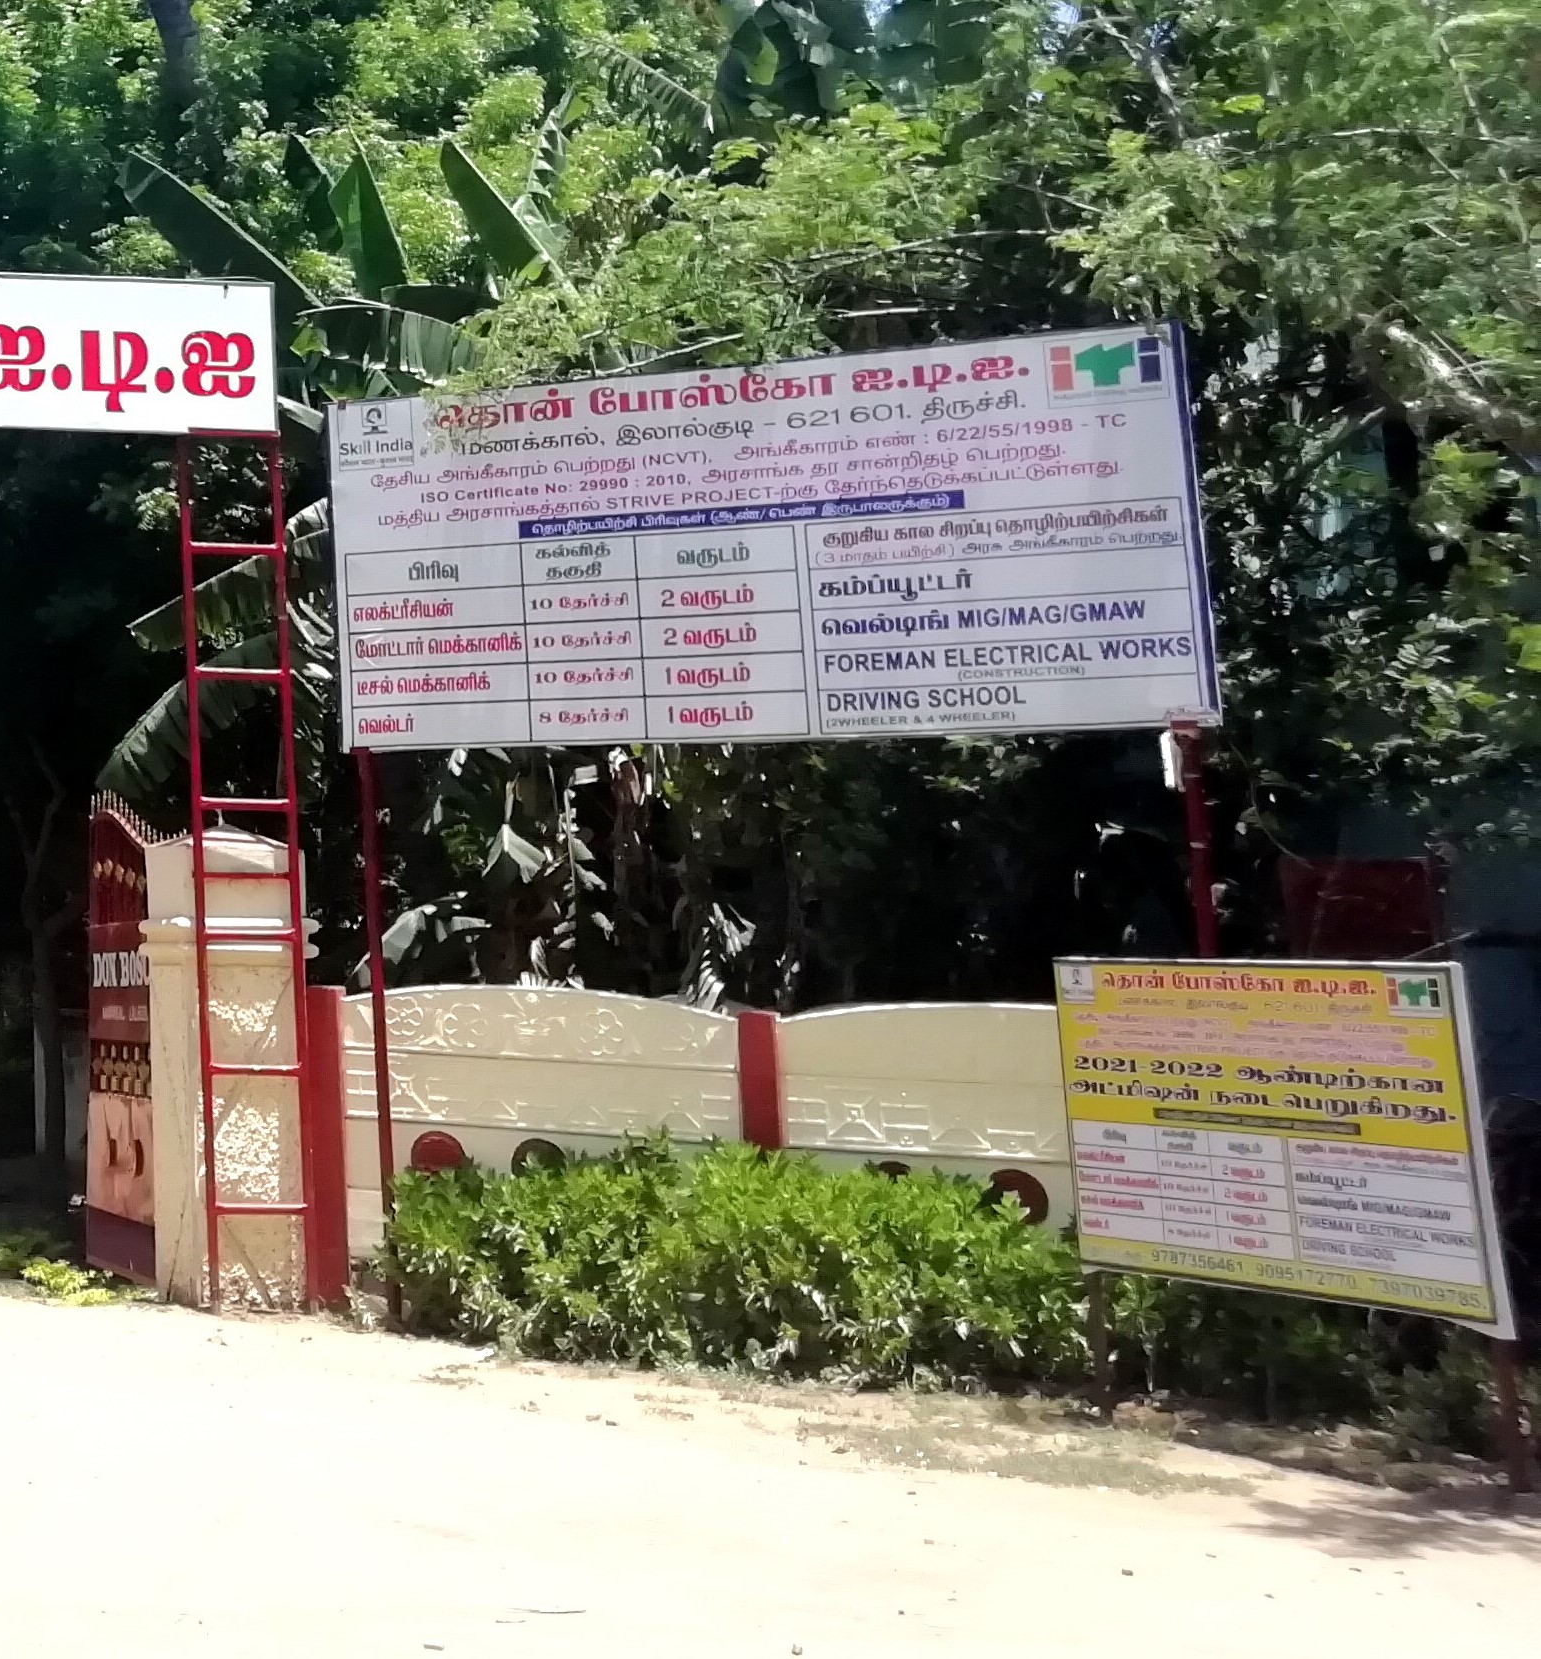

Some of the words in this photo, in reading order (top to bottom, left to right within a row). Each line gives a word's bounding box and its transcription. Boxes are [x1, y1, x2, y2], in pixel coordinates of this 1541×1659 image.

[589, 372, 836, 416] போஸ்கோ
[852, 355, 1031, 393] ஐ.டி.ஐ.
[460, 425, 606, 456] மணக்கால்,
[616, 416, 755, 446] இலால்குடி
[787, 408, 840, 430] 621
[920, 389, 1027, 424] திருச்சி.
[339, 440, 371, 456] Skill
[375, 437, 413, 453] India
[370, 471, 430, 492] தேசிய
[437, 459, 548, 483] அங்கீகாரம்
[554, 454, 636, 476] பெற்றது
[734, 435, 858, 460] அங்கீகாரம்
[865, 430, 917, 450] எண்
[937, 417, 1073, 444] 6/22/55/1998
[1095, 413, 1128, 430] TC
[420, 490, 450, 505] ISO
[455, 484, 539, 502] Certificate
[545, 481, 573, 495] No:
[579, 477, 629, 493] 29990
[646, 473, 692, 488] 2010,
[702, 461, 804, 484] அரசாங்க
[811, 460, 839, 479] தர
[846, 448, 961, 474] சான்றிதழ்
[966, 440, 1066, 463] பெற்றது.
[378, 508, 441, 530] மத்திய
[446, 497, 601, 523] அரசாங்கத்தால்
[606, 491, 676, 511] STRIVE
[531, 515, 639, 537] தொழிற்பயிற்சி
[641, 512, 707, 528] பிரிவுகள்
[822, 526, 889, 549] குறுகிய
[893, 523, 935, 541] கால
[938, 518, 991, 540] சிறப்பு
[995, 504, 1169, 536] தொழிற்பயிற்சிகள்
[676, 541, 751, 568] வருடம்
[408, 560, 459, 582] பிரிவு
[545, 561, 602, 581] தகுதி
[660, 589, 675, 608] 2
[680, 583, 755, 610] வருடம்
[818, 568, 973, 602] கம்ப்யூட்டர்
[530, 598, 553, 611] 10
[559, 592, 629, 611] தேர்ச்சி
[821, 609, 949, 637] வெல்டிங்
[958, 600, 1146, 629] MIG/MAG/GMAW
[355, 636, 425, 659] மோட்டார்
[428, 630, 523, 656] மெக்கானிக்
[533, 636, 555, 648] 10
[561, 630, 632, 649] தேர்ச்சி
[663, 627, 678, 647] 2
[683, 621, 757, 648] வருடம்
[824, 649, 936, 674] FOREMAN
[944, 641, 1093, 669] ELECTRICAL
[1098, 635, 1192, 661] WORKS
[357, 675, 394, 697] டீசல்
[397, 670, 491, 694] மெக்கானிக்
[534, 672, 557, 684] 10
[563, 667, 633, 685] தேர்ச்சி
[665, 666, 672, 686] 1
[677, 661, 751, 688] வருடம்
[957, 665, 1086, 681] (CONSTRUCTION)
[827, 690, 920, 713] DRIVING
[927, 684, 1027, 709] SCHOOL
[358, 713, 415, 735] வெல்டர்
[539, 712, 552, 724] 8
[558, 708, 629, 725] தேர்ச்சி
[667, 705, 674, 724] 1
[679, 701, 754, 728] வருடம்
[826, 714, 908, 729] (2WHEELER
[938, 711, 1016, 725] WHEELER)
[92, 951, 118, 988] DON
[1101, 969, 1165, 990] தொன்
[1172, 970, 1285, 992] போஸ்கோ
[1074, 1055, 1224, 1078] 2021-2022
[1234, 1064, 1445, 1094] ஆண்டிற்கான
[1069, 1079, 1200, 1103] அட்மிஷன்
